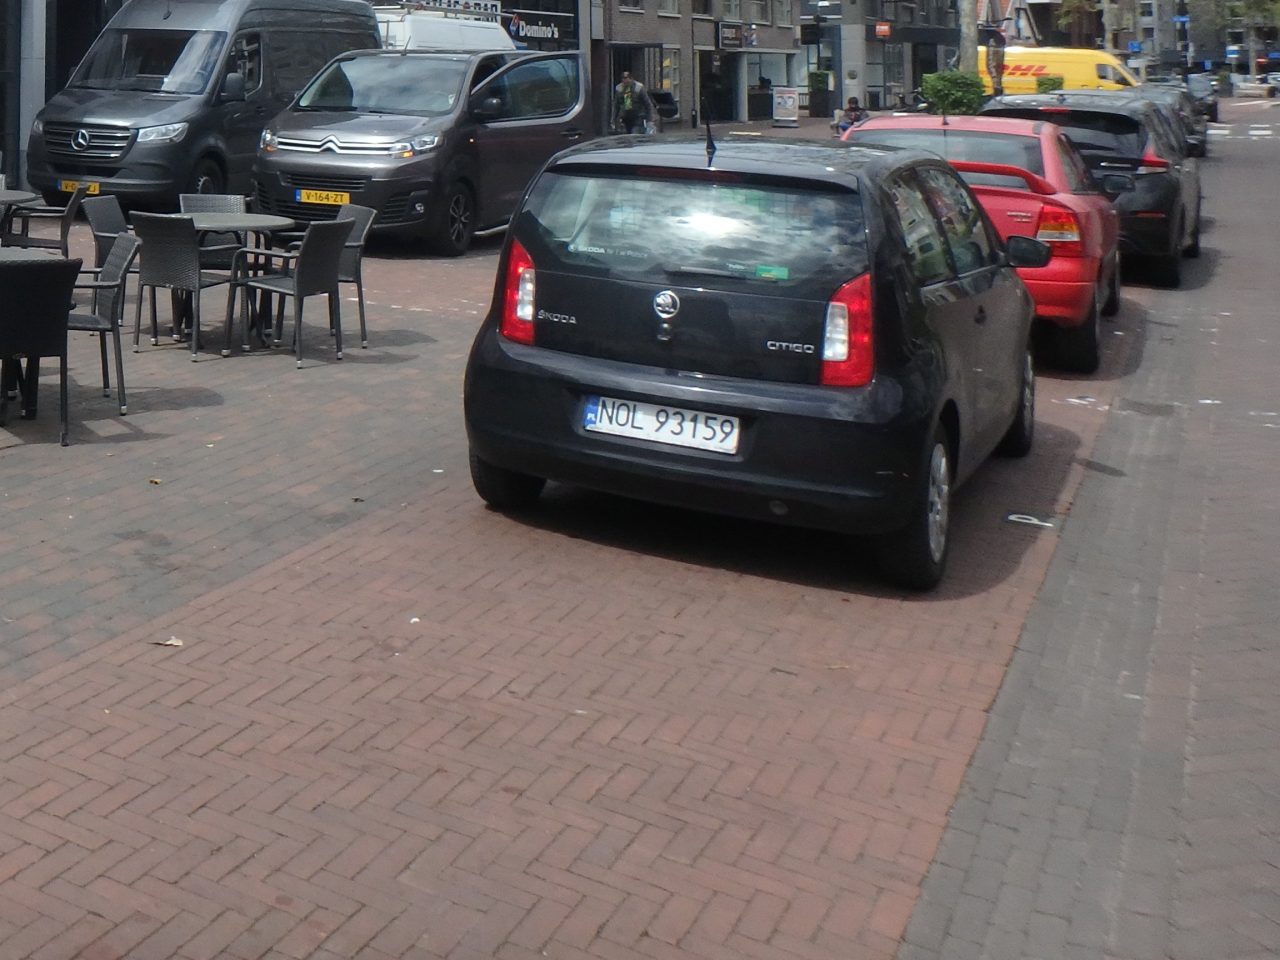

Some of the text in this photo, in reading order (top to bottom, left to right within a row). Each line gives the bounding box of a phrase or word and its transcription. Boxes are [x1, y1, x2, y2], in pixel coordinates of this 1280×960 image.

[519, 21, 559, 38] Domino's
[766, 340, 815, 354] CITIGO
[586, 412, 597, 422] PL
[598, 399, 736, 444] NOL 93159
